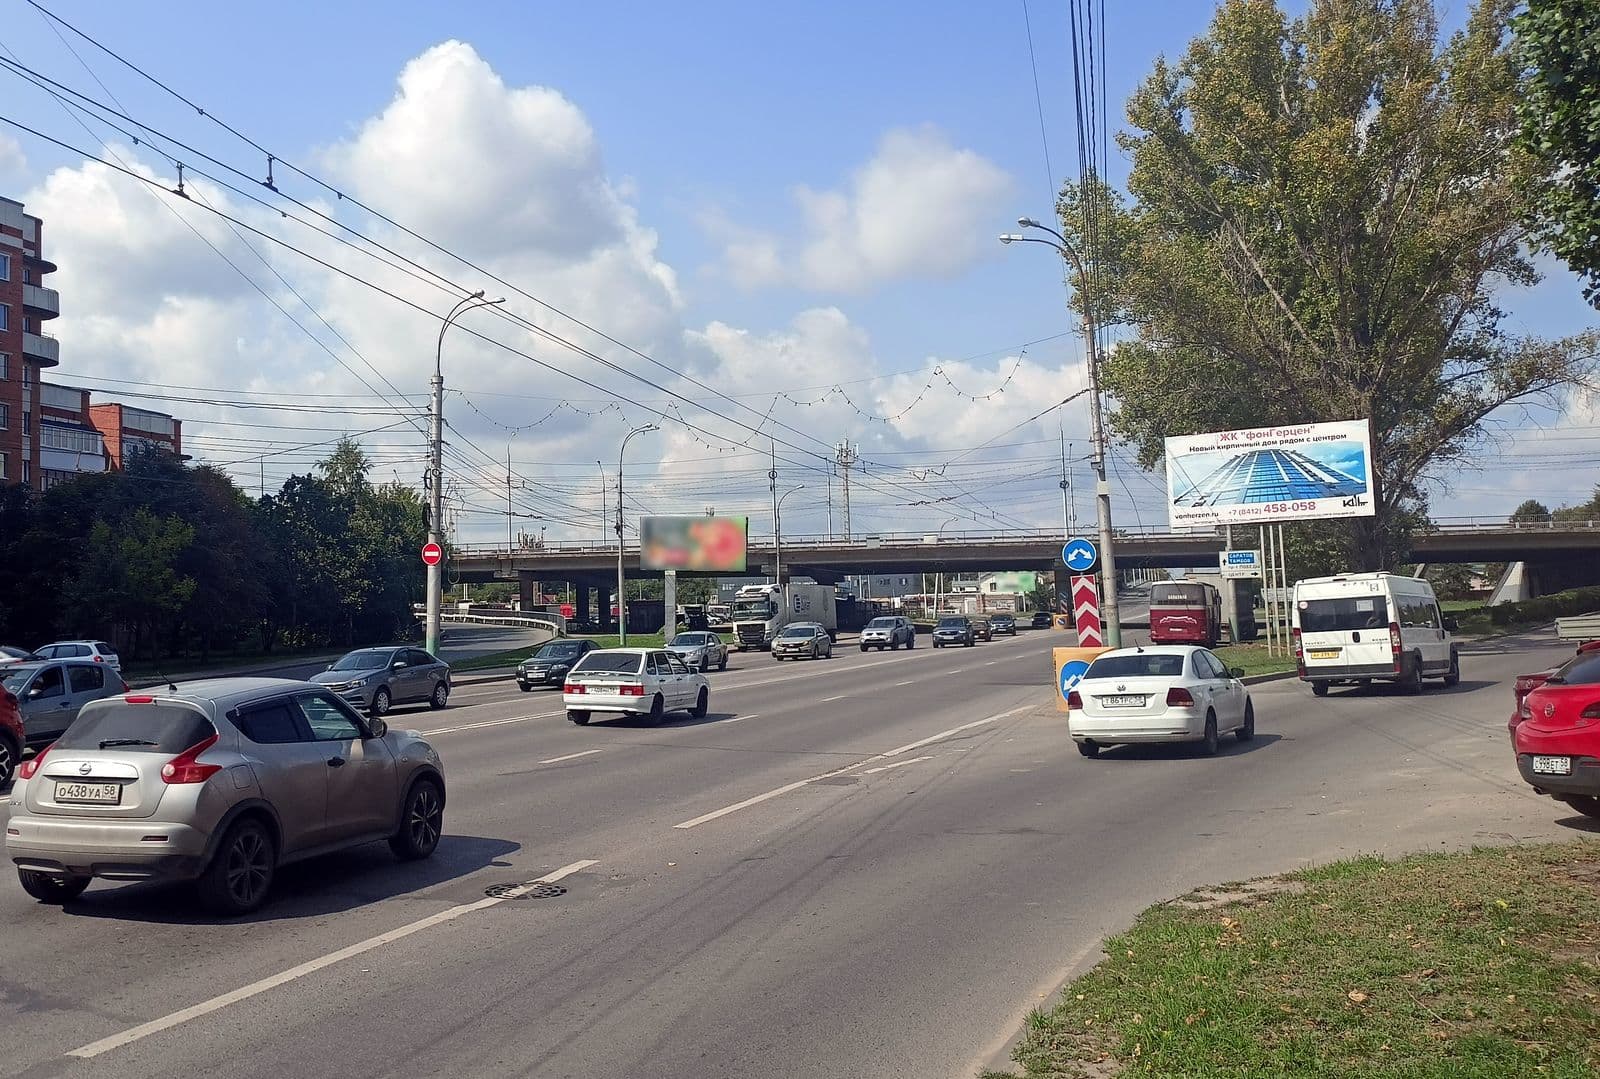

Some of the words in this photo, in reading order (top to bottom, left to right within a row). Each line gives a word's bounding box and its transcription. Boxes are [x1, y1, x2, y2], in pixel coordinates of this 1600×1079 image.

[1217, 442, 1260, 451] кирпичный
[1262, 439, 1278, 447] дом
[1279, 437, 1305, 446] рядом
[1313, 433, 1347, 442] центром
[1220, 432, 1238, 442] ЖК
[1238, 508, 1262, 516] (8412)
[1263, 501, 1316, 513] 458-058
[104, 785, 116, 796] 58
